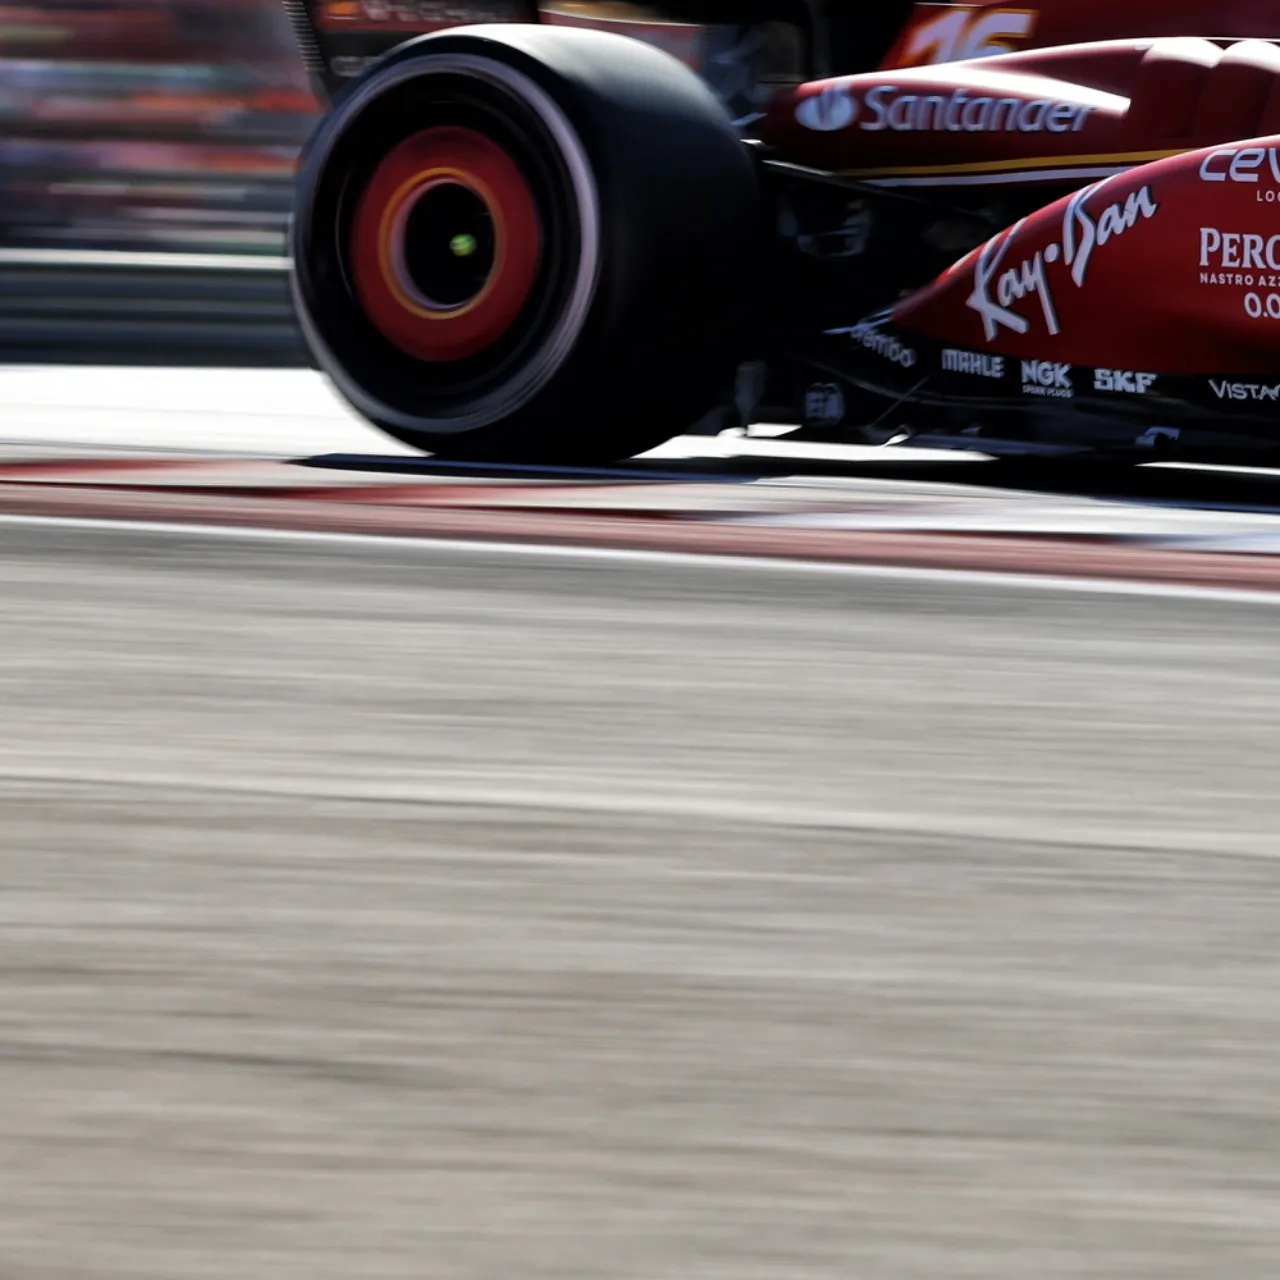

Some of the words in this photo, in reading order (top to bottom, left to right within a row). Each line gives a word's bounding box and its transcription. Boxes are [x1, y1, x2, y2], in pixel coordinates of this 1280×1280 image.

[860, 84, 1097, 132] Santander
[1200, 272, 1254, 286] NASTRO
[941, 349, 1005, 378] MAHLE
[1021, 359, 1073, 389] NGK
[1094, 368, 1157, 394] SKF
